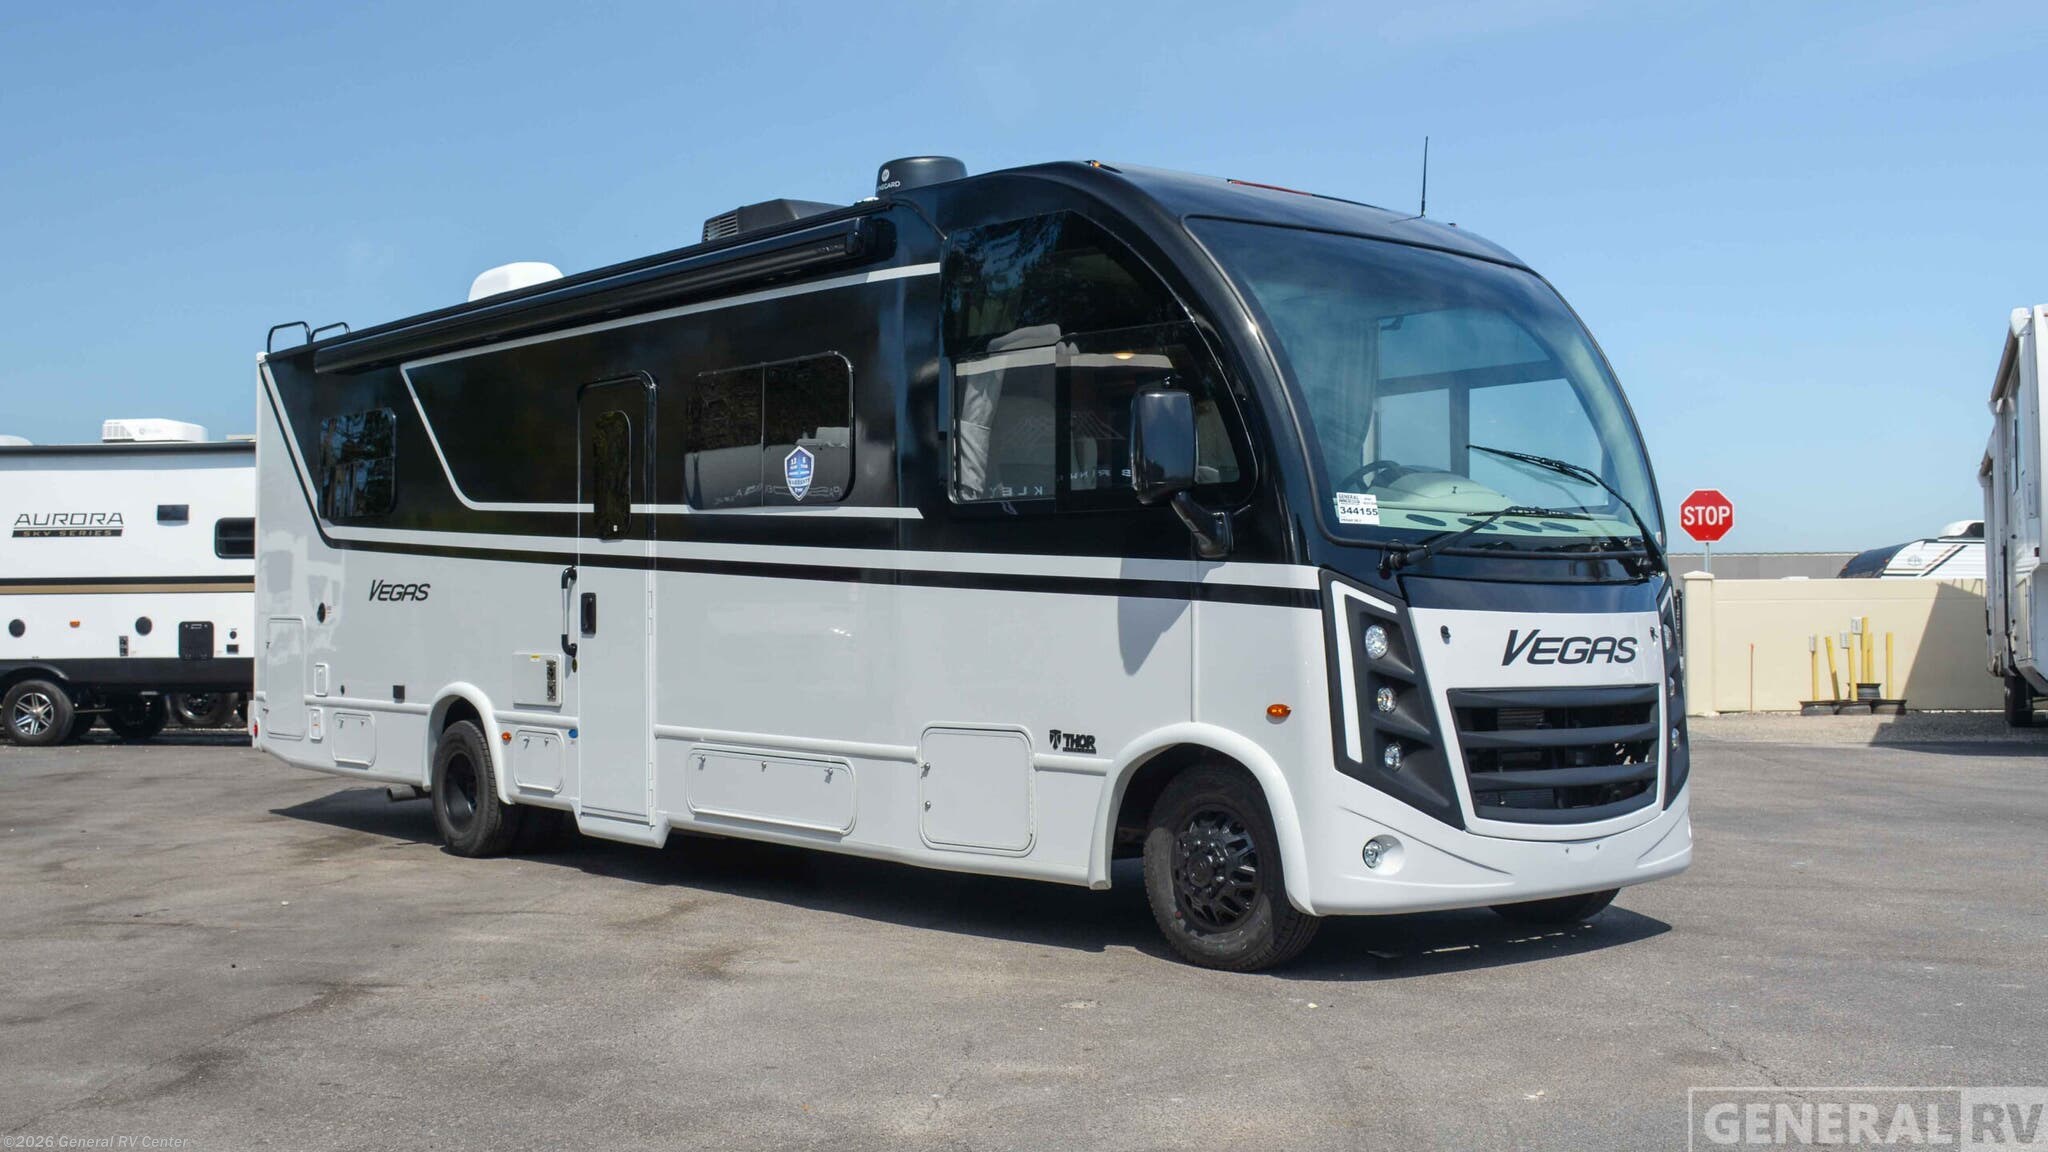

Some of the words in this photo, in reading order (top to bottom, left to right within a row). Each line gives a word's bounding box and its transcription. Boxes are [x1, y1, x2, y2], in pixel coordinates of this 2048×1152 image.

[14, 512, 124, 526] AURORA
[1340, 506, 1379, 516] 344155
[1683, 505, 1731, 526] STOP
[58, 529, 112, 537] SERIES
[369, 579, 431, 602] VEGAS
[1501, 629, 1638, 666] VEGAS
[1062, 733, 1096, 750] THOR
